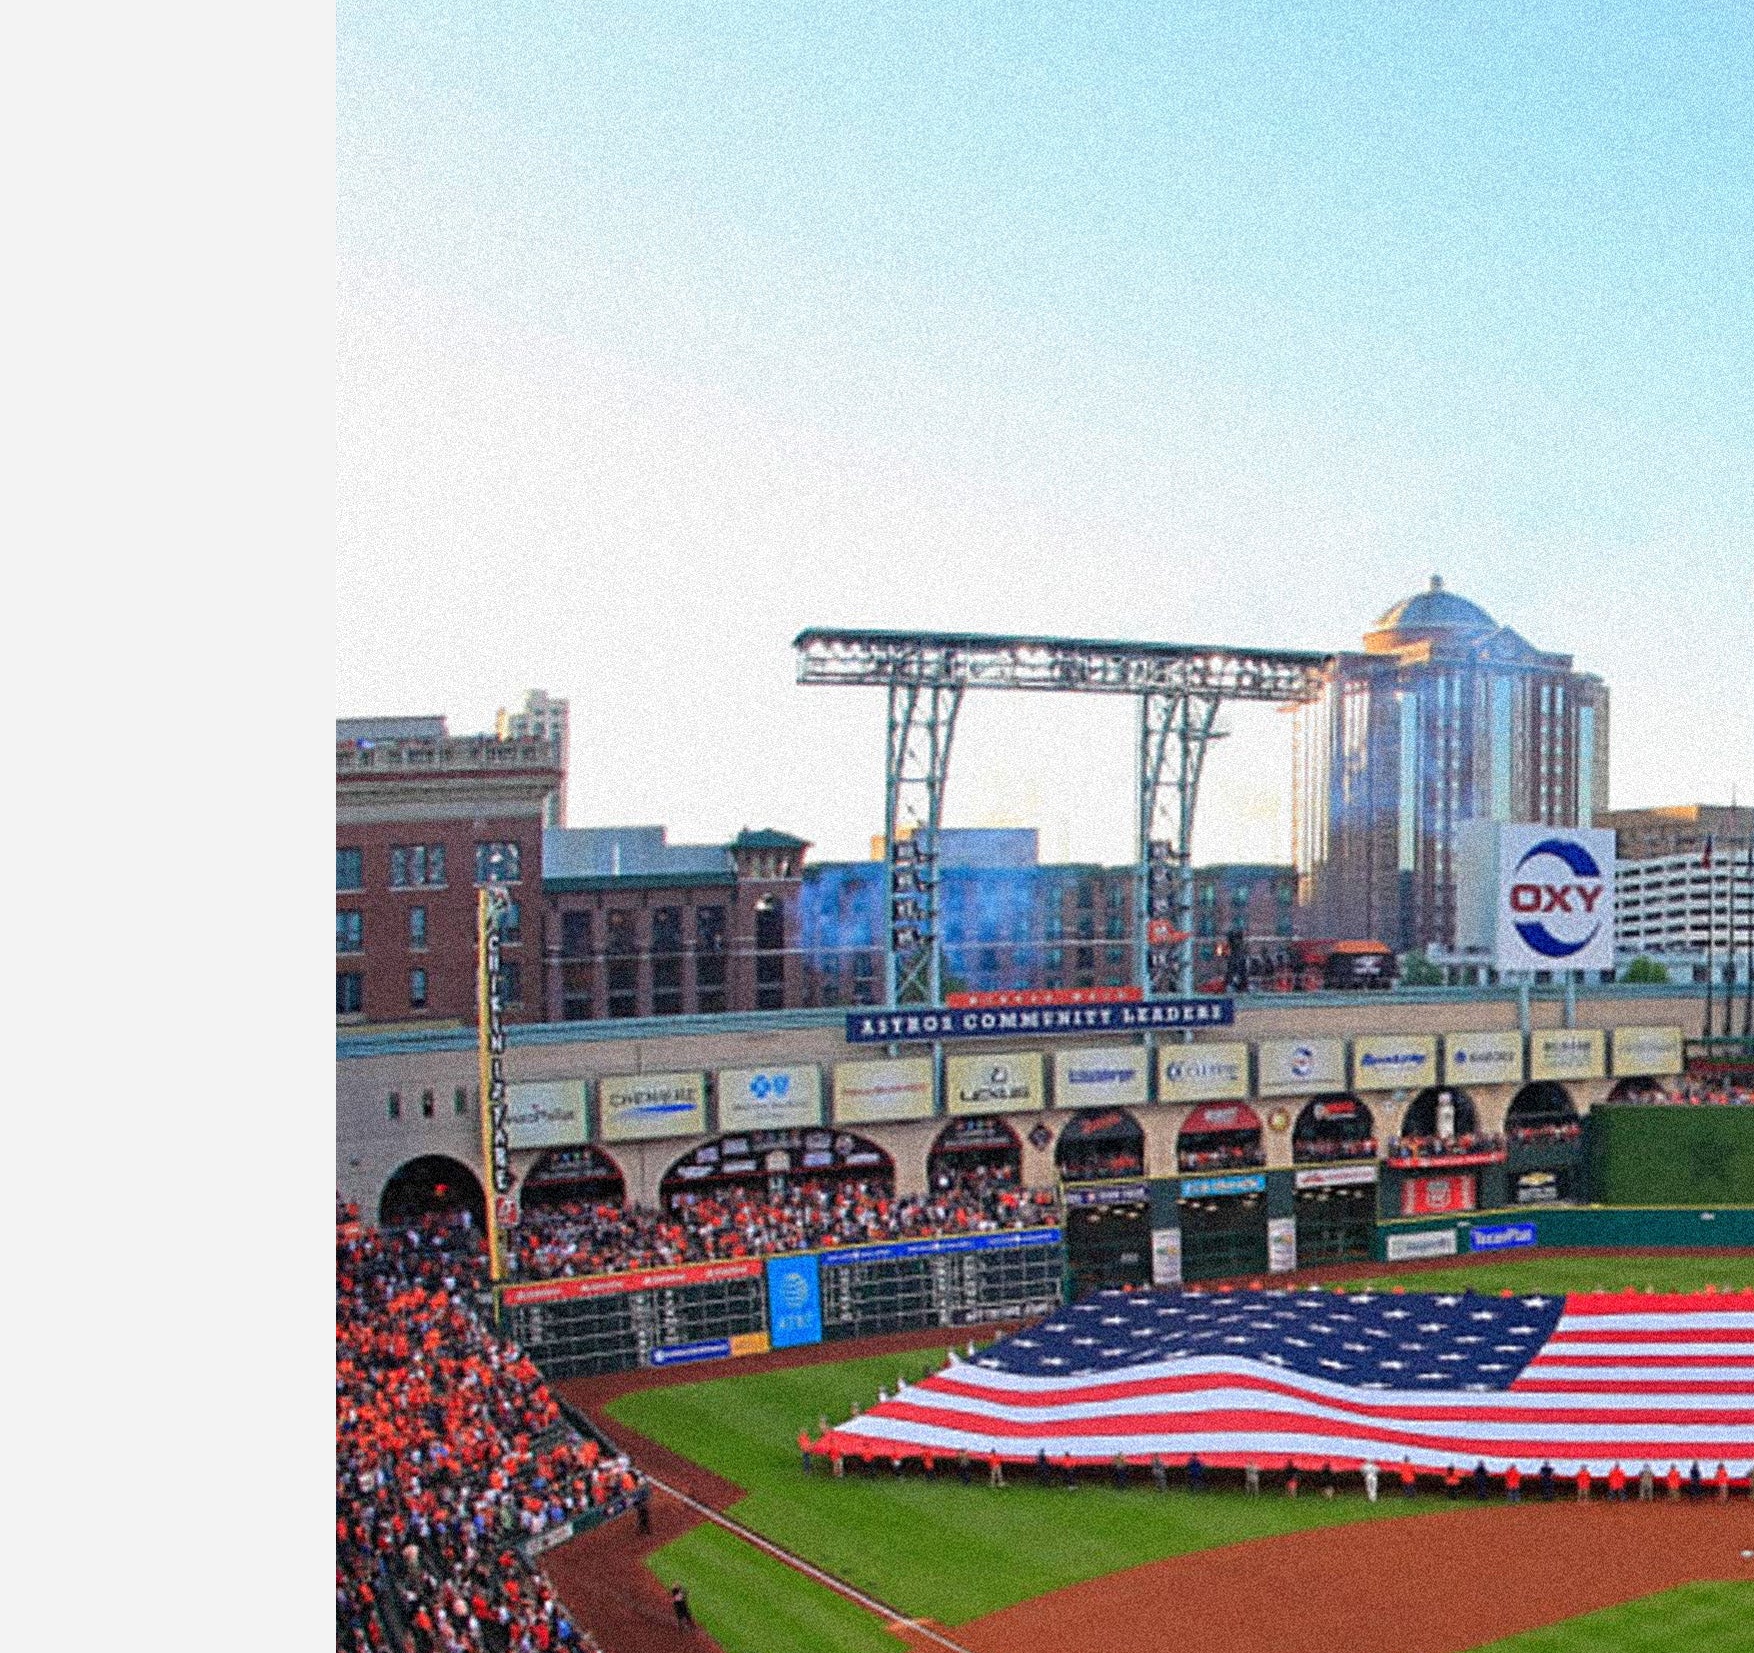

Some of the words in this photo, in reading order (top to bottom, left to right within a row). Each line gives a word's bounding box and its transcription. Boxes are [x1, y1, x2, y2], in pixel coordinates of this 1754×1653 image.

[1509, 883, 1604, 914] OXY
[859, 1013, 953, 1037] ASTROS
[963, 1004, 1113, 1031] COMMUNITY
[1123, 1002, 1222, 1026] LEADERS
